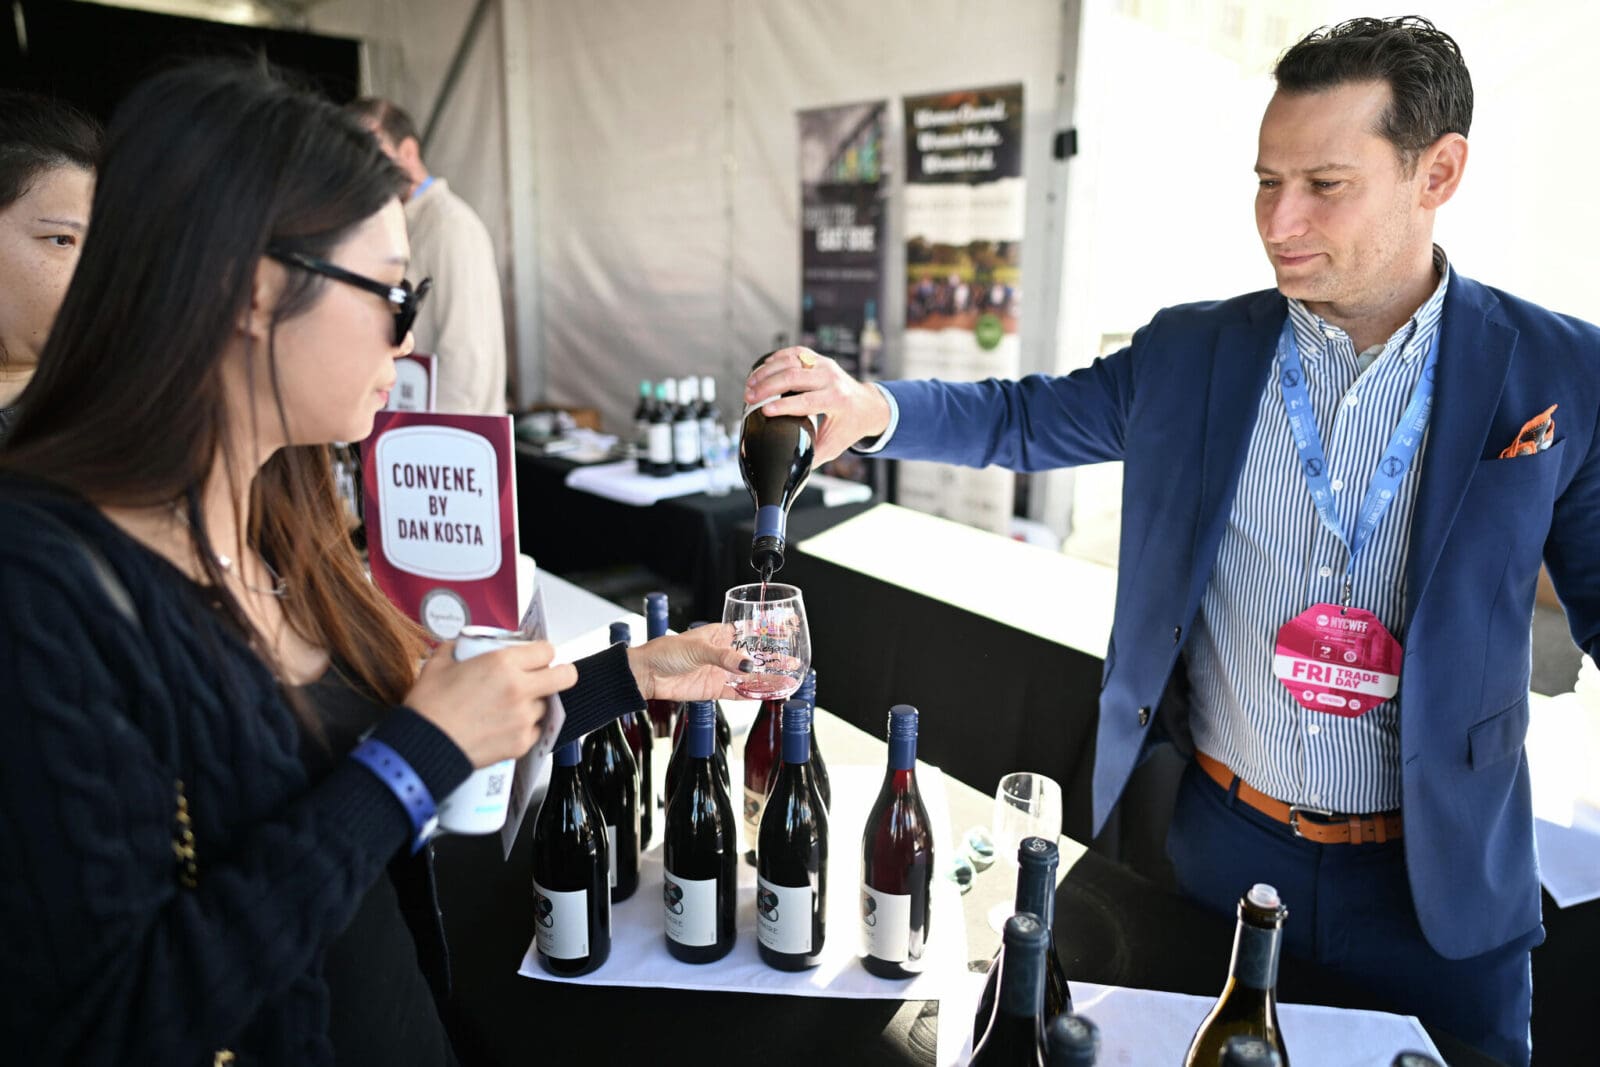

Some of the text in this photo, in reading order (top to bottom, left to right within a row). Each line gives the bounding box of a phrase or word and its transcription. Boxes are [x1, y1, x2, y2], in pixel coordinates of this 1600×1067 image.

[392, 463, 483, 497] CONVENE,
[429, 495, 448, 516] BY
[398, 519, 484, 546] DAN KOSTA
[1330, 616, 1369, 633] NYCWFF
[731, 640, 790, 656] Mohegan
[753, 654, 781, 666] Sun
[1292, 661, 1332, 684] FRI
[1336, 668, 1379, 684] TRADE
[1335, 677, 1361, 689] DAY
